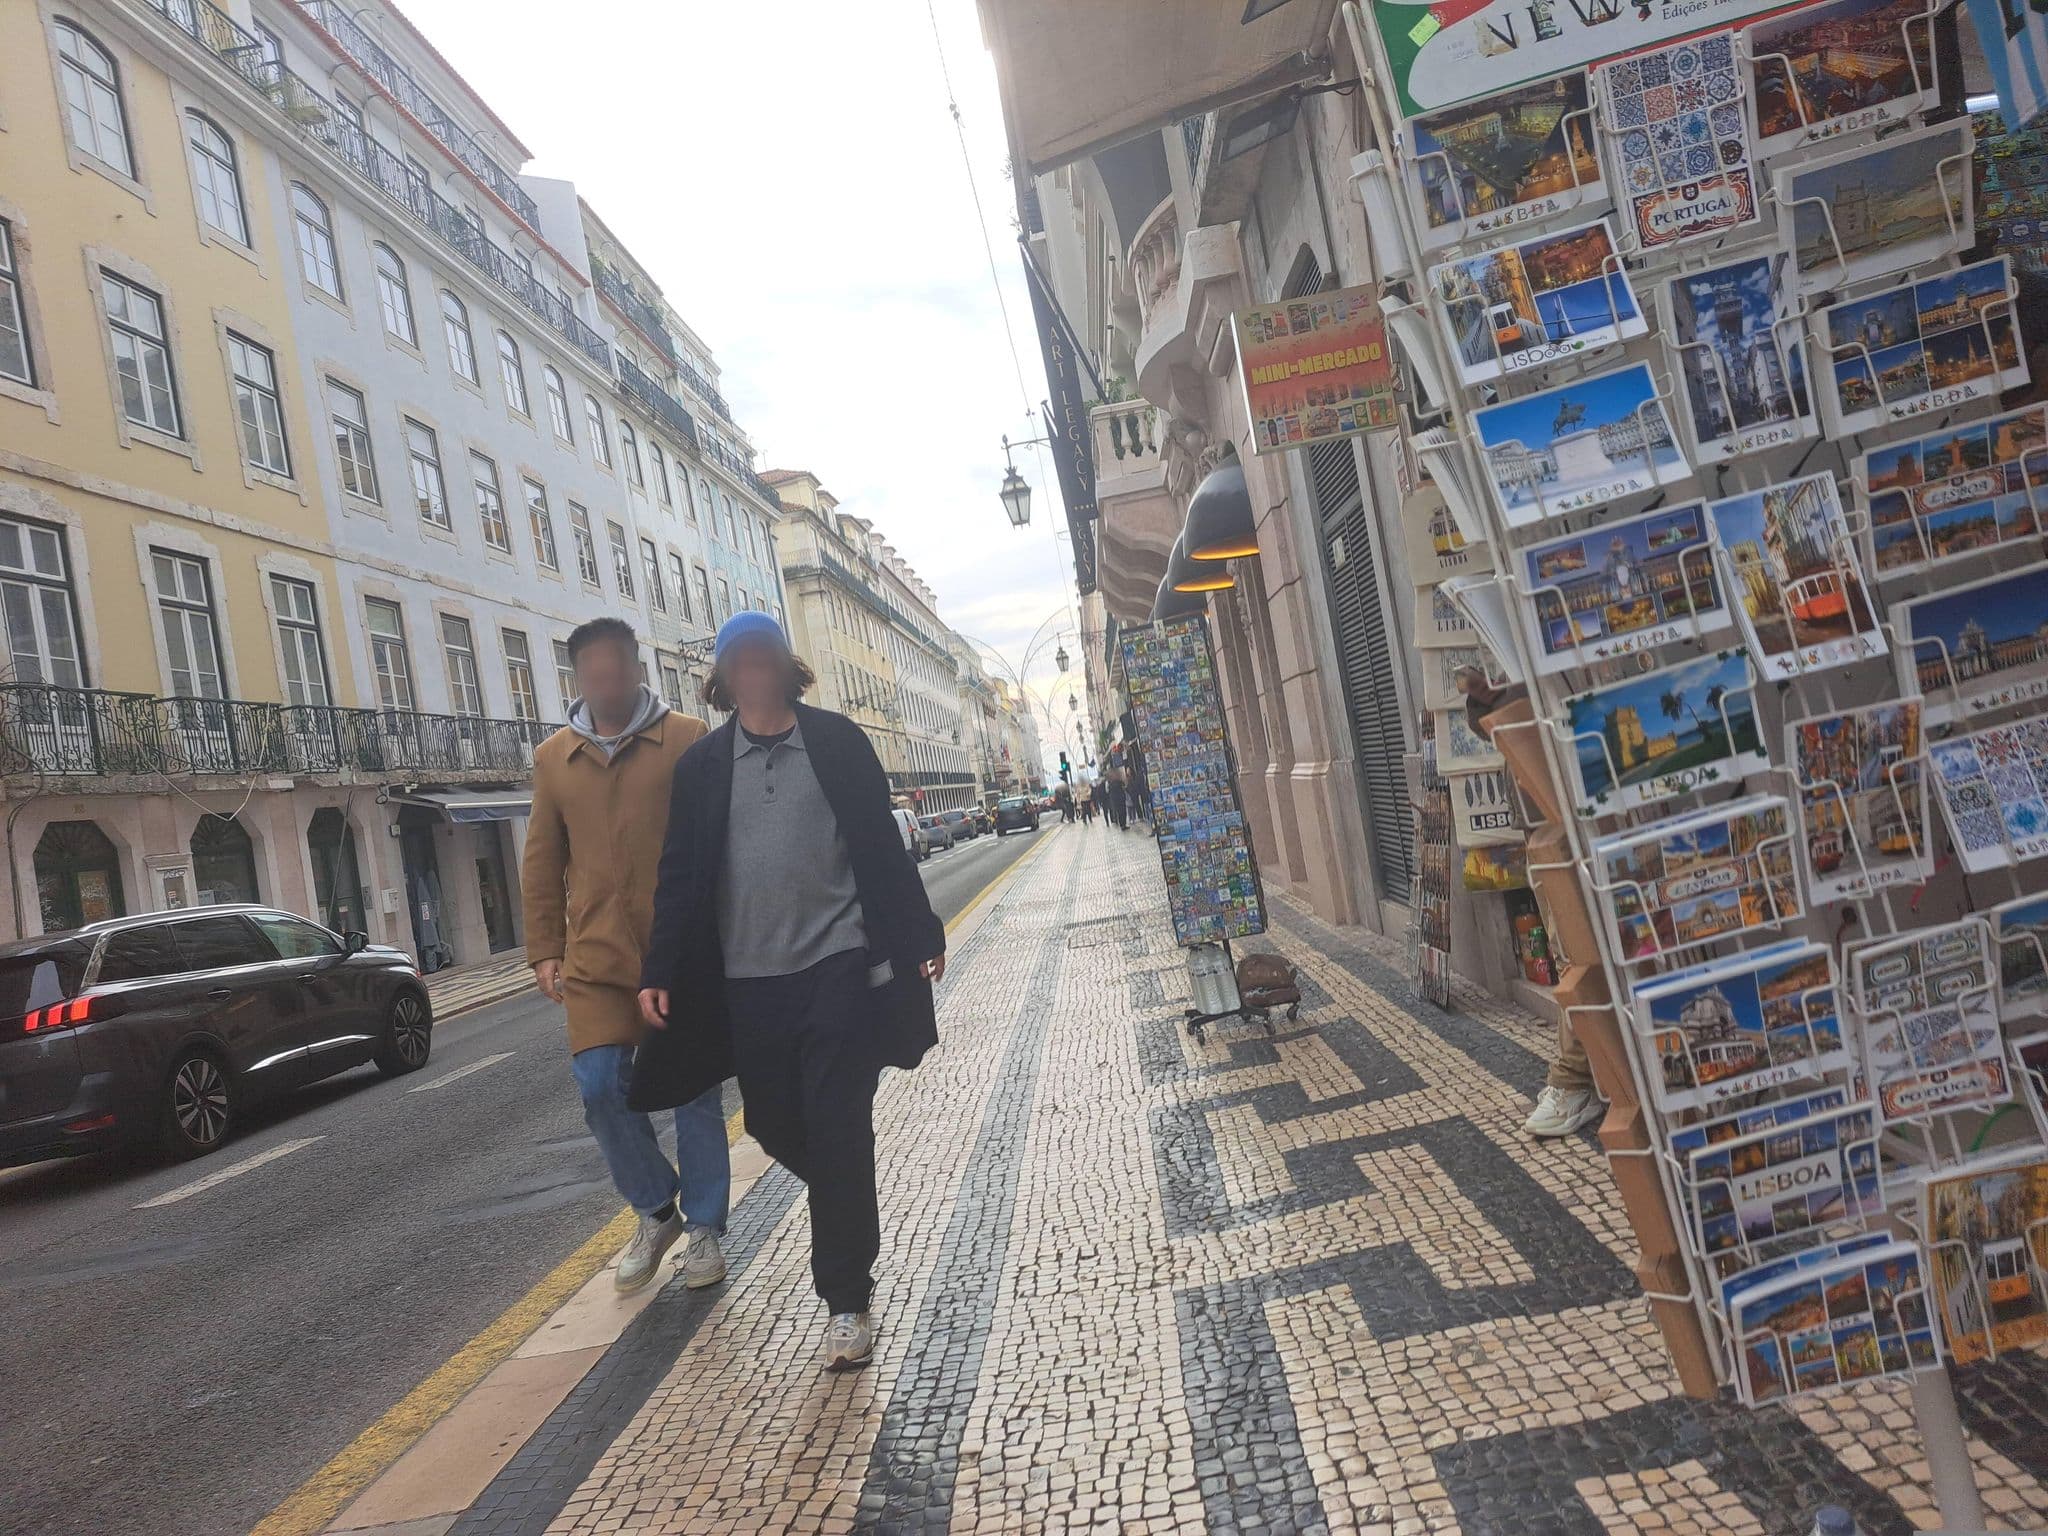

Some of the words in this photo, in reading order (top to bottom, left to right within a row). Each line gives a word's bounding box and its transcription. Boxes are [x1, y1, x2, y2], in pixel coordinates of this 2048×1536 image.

[1251, 341, 1382, 385] MINI-MERCADO
[1050, 326, 1063, 378] ART
[1062, 390, 1088, 491] LEGACY
[1740, 1160, 1832, 1201] LISBOA
